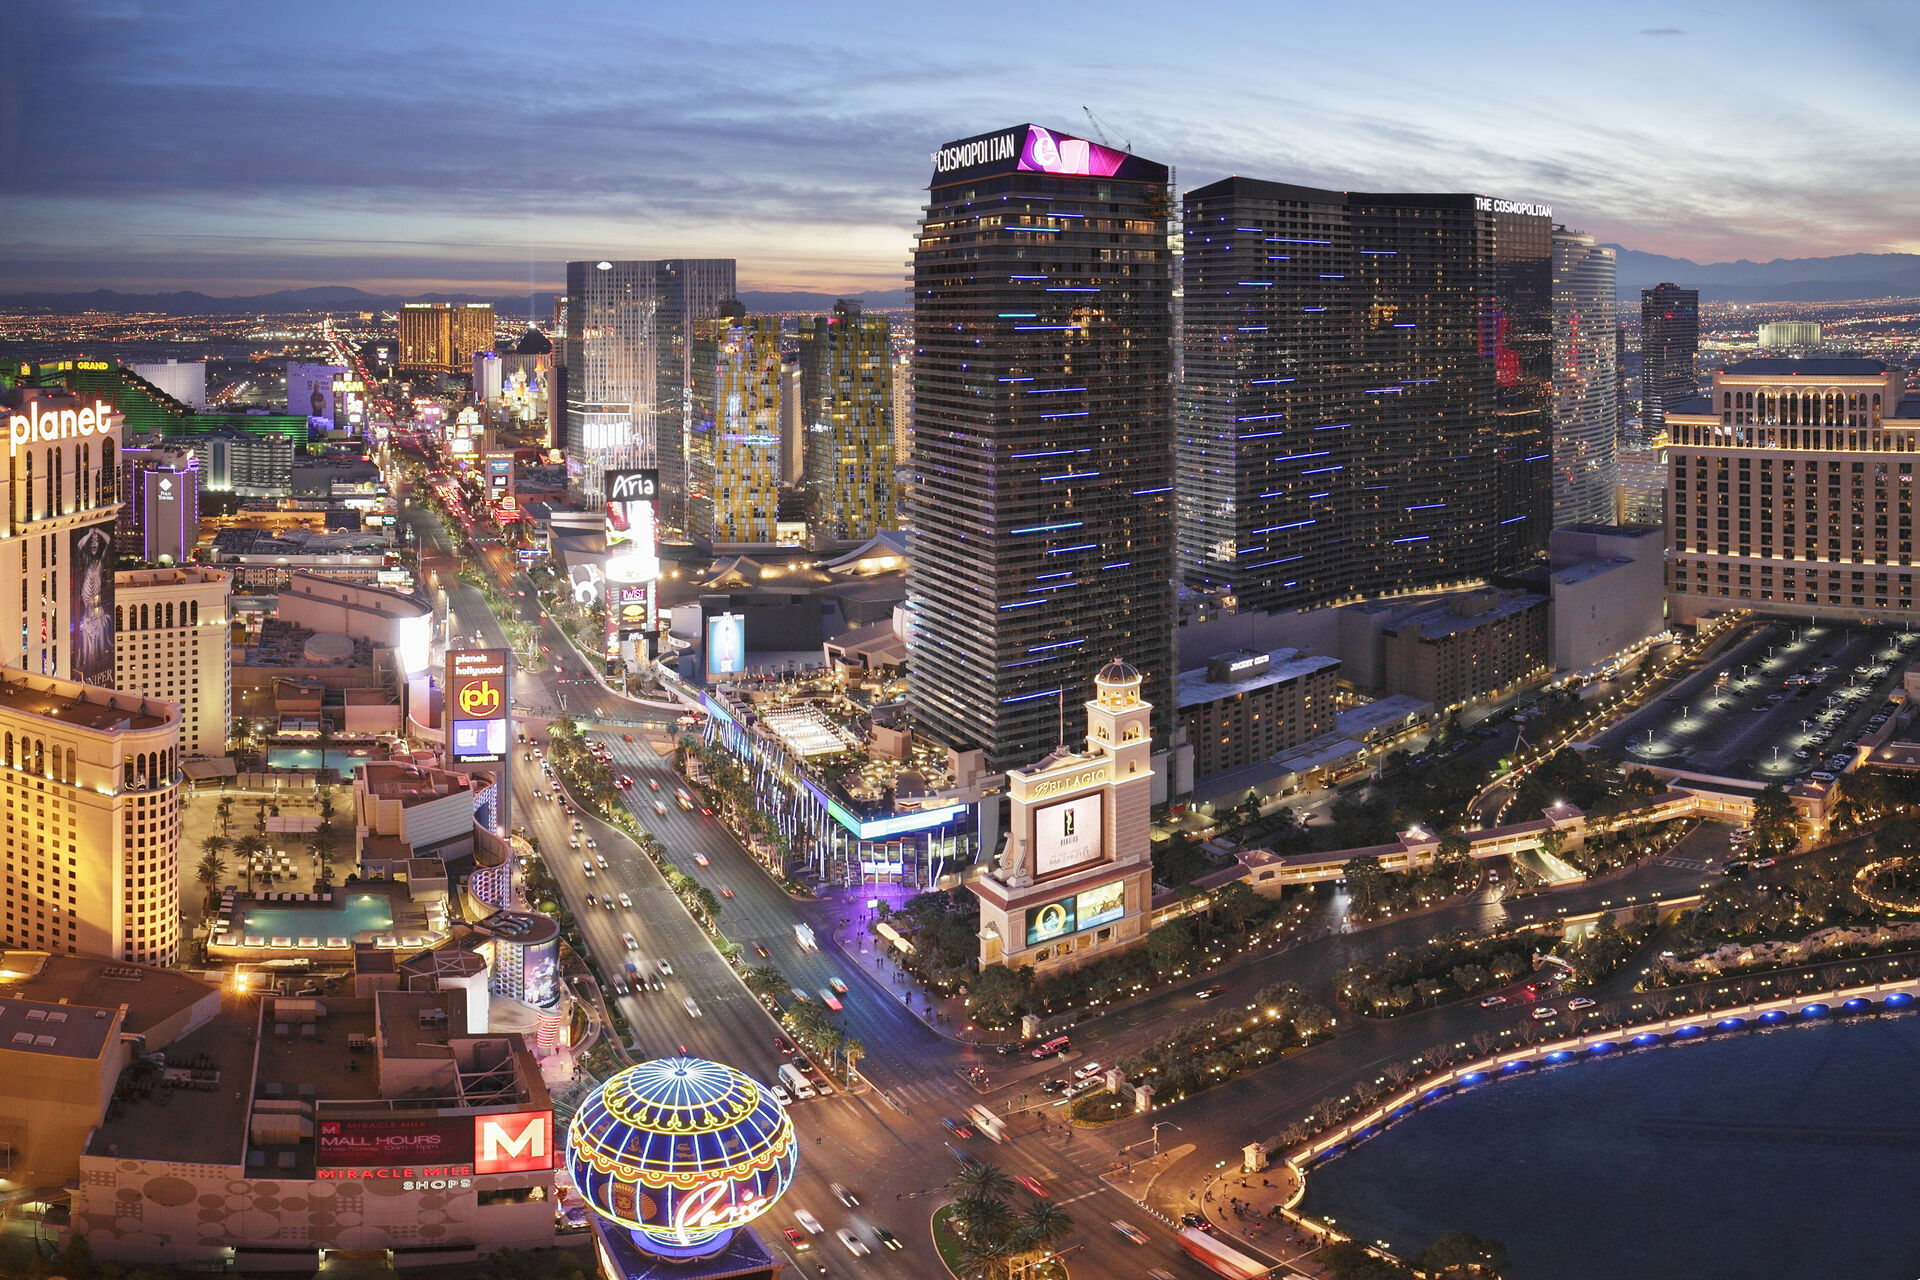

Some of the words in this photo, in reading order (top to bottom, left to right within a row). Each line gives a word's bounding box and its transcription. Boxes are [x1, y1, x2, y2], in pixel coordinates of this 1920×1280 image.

[930, 153, 938, 163] THE
[937, 134, 1015, 172] COSMOPOLITAN
[1475, 197, 1492, 211] THE
[1493, 199, 1552, 217] COSMOPOLITAN
[77, 361, 109, 370] GRAND
[332, 381, 364, 392] MGM
[10, 400, 112, 457] planet
[612, 474, 654, 498] Aria
[622, 588, 645, 599] TWIST
[455, 654, 488, 665] planet
[455, 665, 503, 676] hollywood
[463, 681, 500, 713] ph
[1031, 769, 1105, 798] BELLAGIO
[321, 1137, 372, 1146] MALL
[376, 1135, 441, 1145] HOURS
[483, 1118, 545, 1161] M
[318, 1168, 414, 1179] MIRACLE
[424, 1166, 472, 1177] MILE
[402, 1178, 472, 1191] SHOPS
[675, 1180, 768, 1247] Paris
